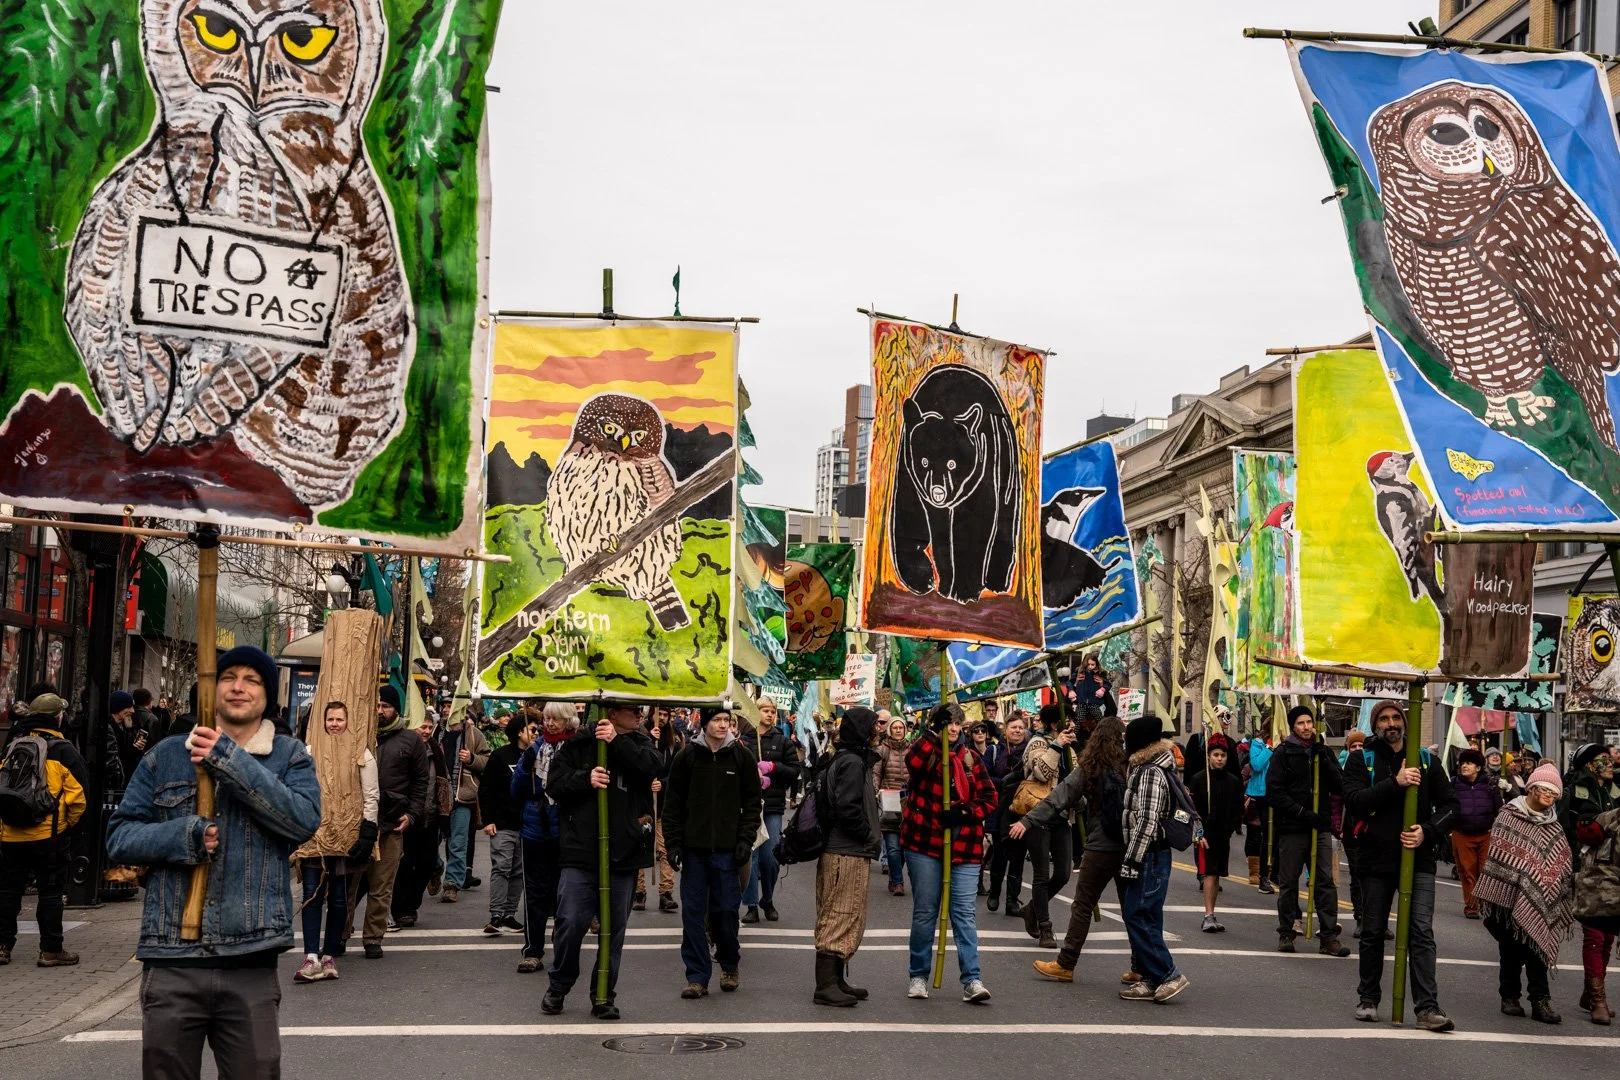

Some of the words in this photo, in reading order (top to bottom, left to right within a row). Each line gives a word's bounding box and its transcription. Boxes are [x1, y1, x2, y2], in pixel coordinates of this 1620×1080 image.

[174, 235, 267, 285] NO
[149, 278, 326, 324] TRESPASS
[1454, 486, 1505, 505] Spotted
[1508, 484, 1528, 498] owl
[1474, 571, 1513, 597] Hairy
[1466, 598, 1530, 618] Woodpecker
[517, 608, 611, 632] northern
[545, 655, 587, 674] OWL
[846, 664, 862, 672] ITED
